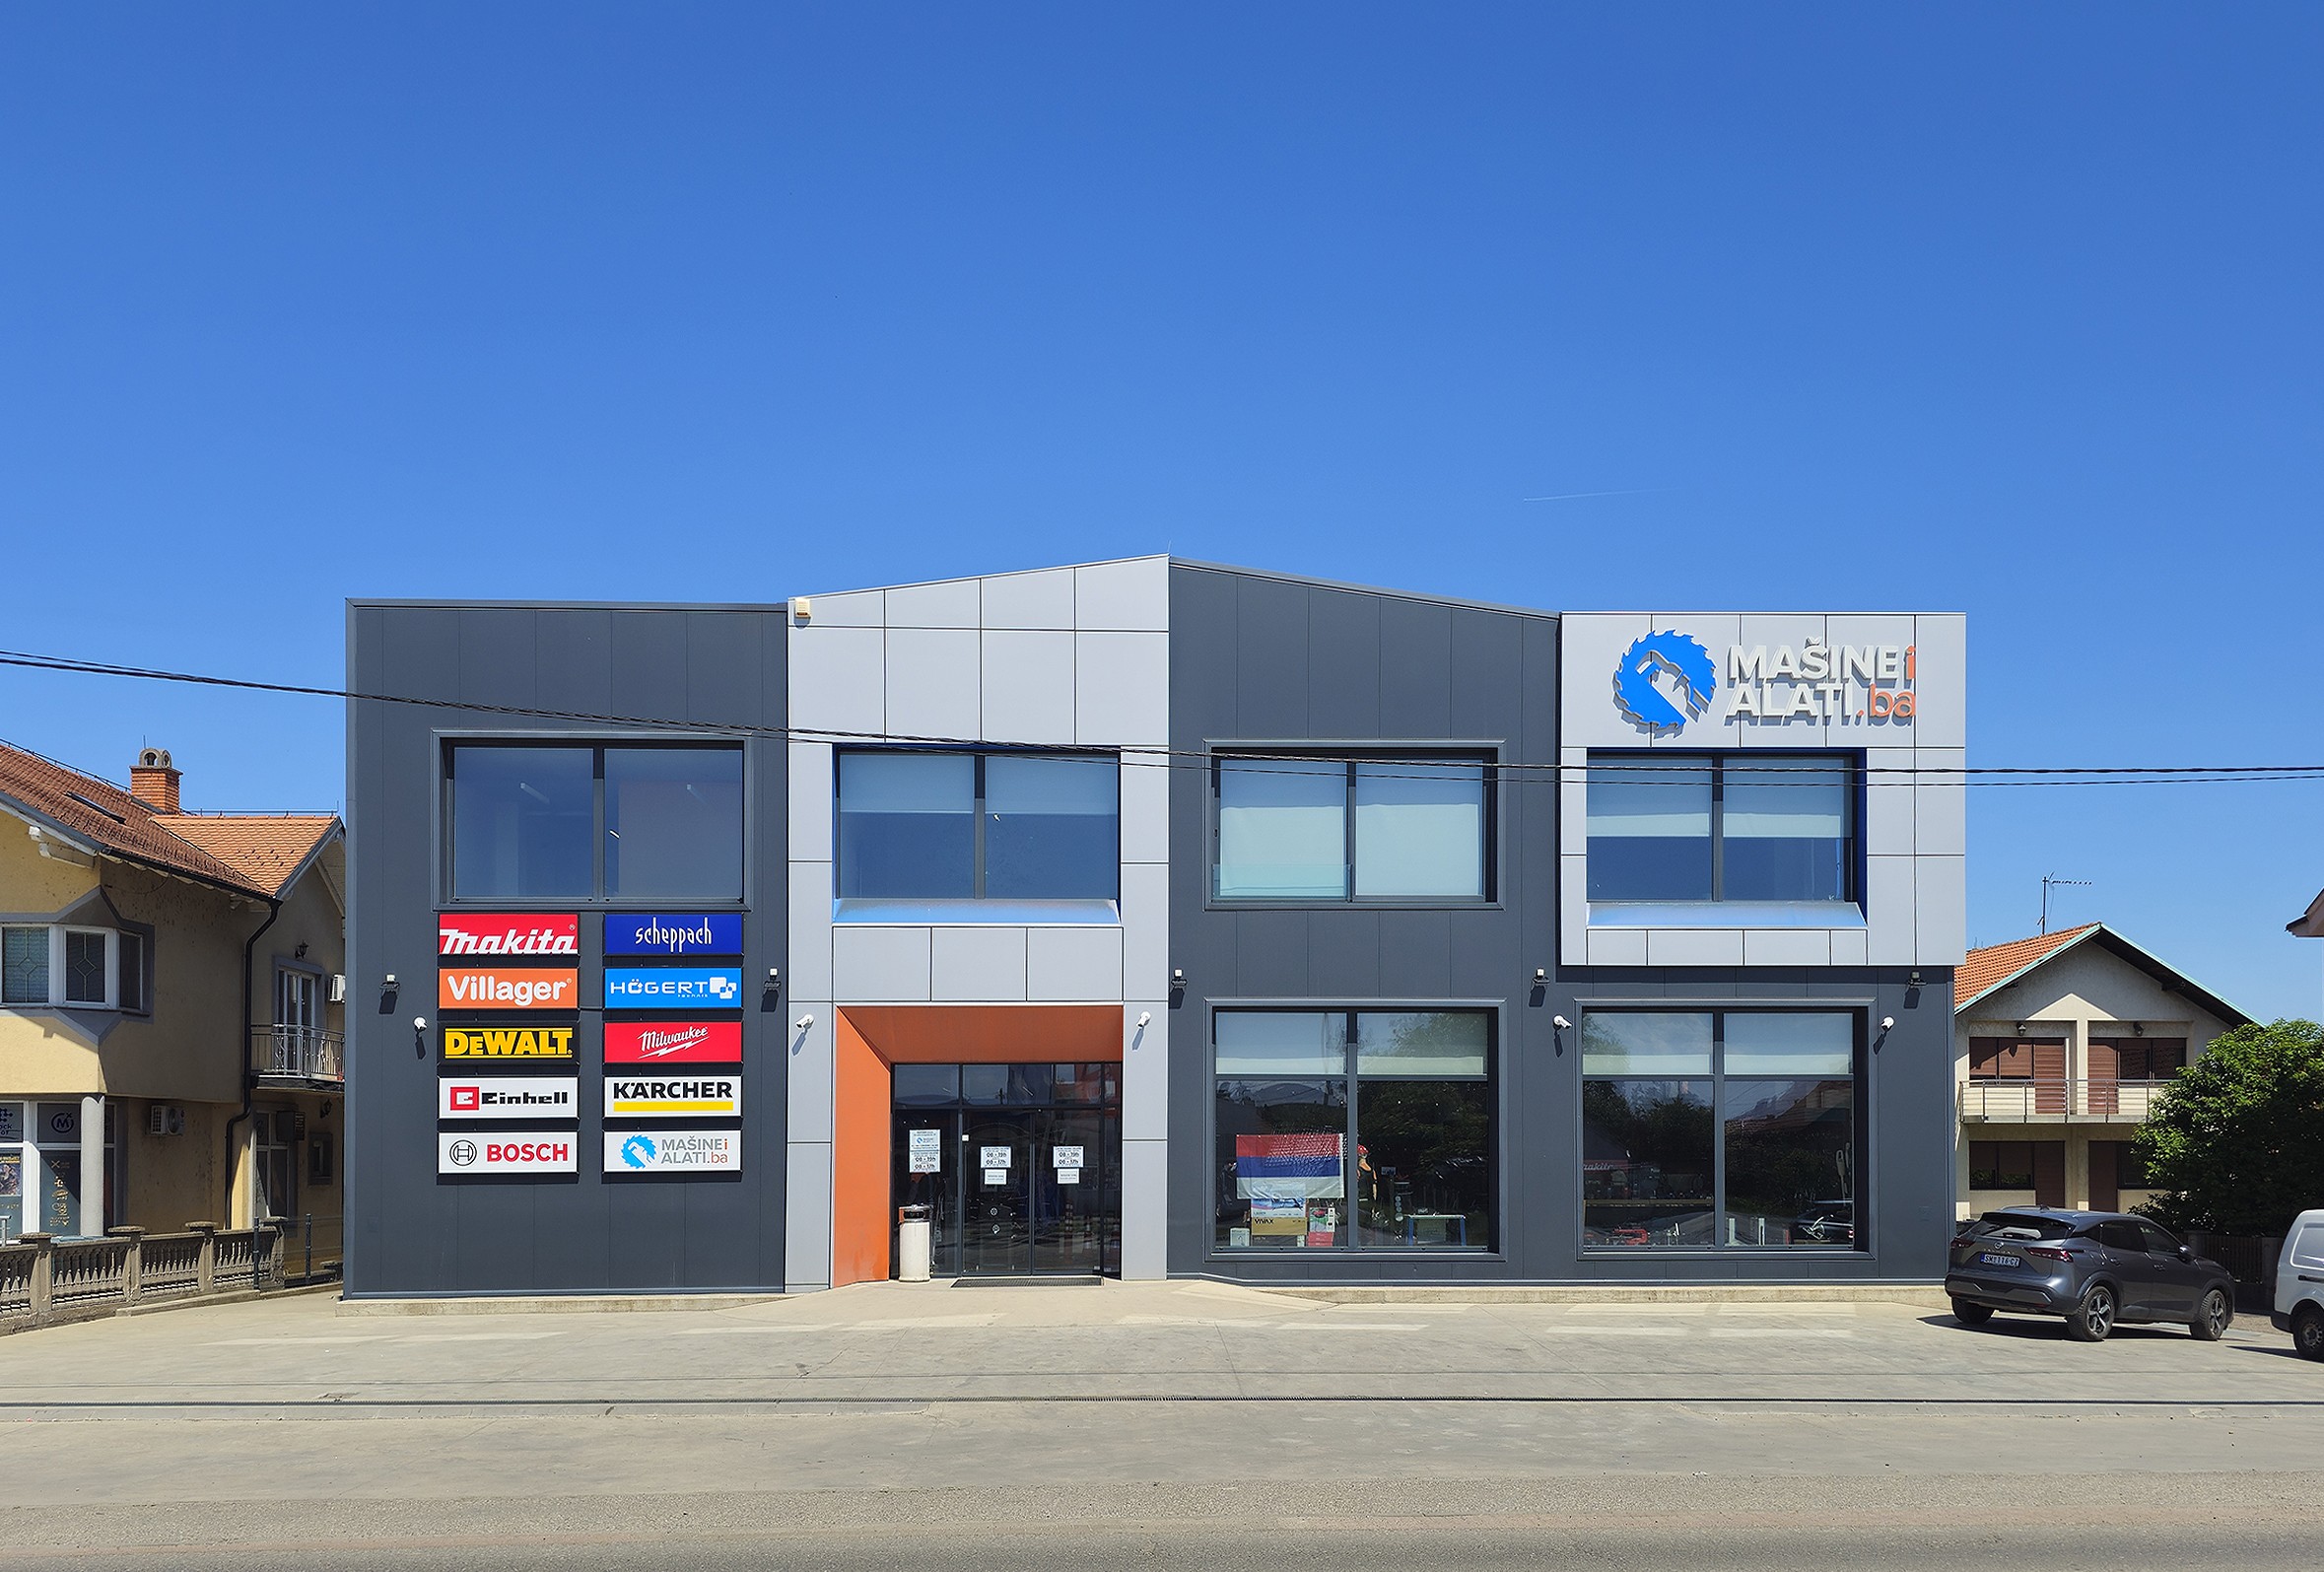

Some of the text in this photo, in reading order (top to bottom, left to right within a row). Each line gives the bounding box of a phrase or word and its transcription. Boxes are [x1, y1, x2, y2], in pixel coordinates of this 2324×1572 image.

[1726, 683, 1917, 718] ALATI.ba
[635, 917, 712, 953] scheppach
[447, 975, 568, 1006] Villager
[610, 978, 709, 994] HÖGERT
[637, 1026, 709, 1052] Milwaukee
[481, 1091, 569, 1105] Einhell
[613, 1081, 733, 1099] KÄRCHER
[487, 1143, 569, 1162] BOSCH
[660, 1151, 728, 1164] ALATI.ba
